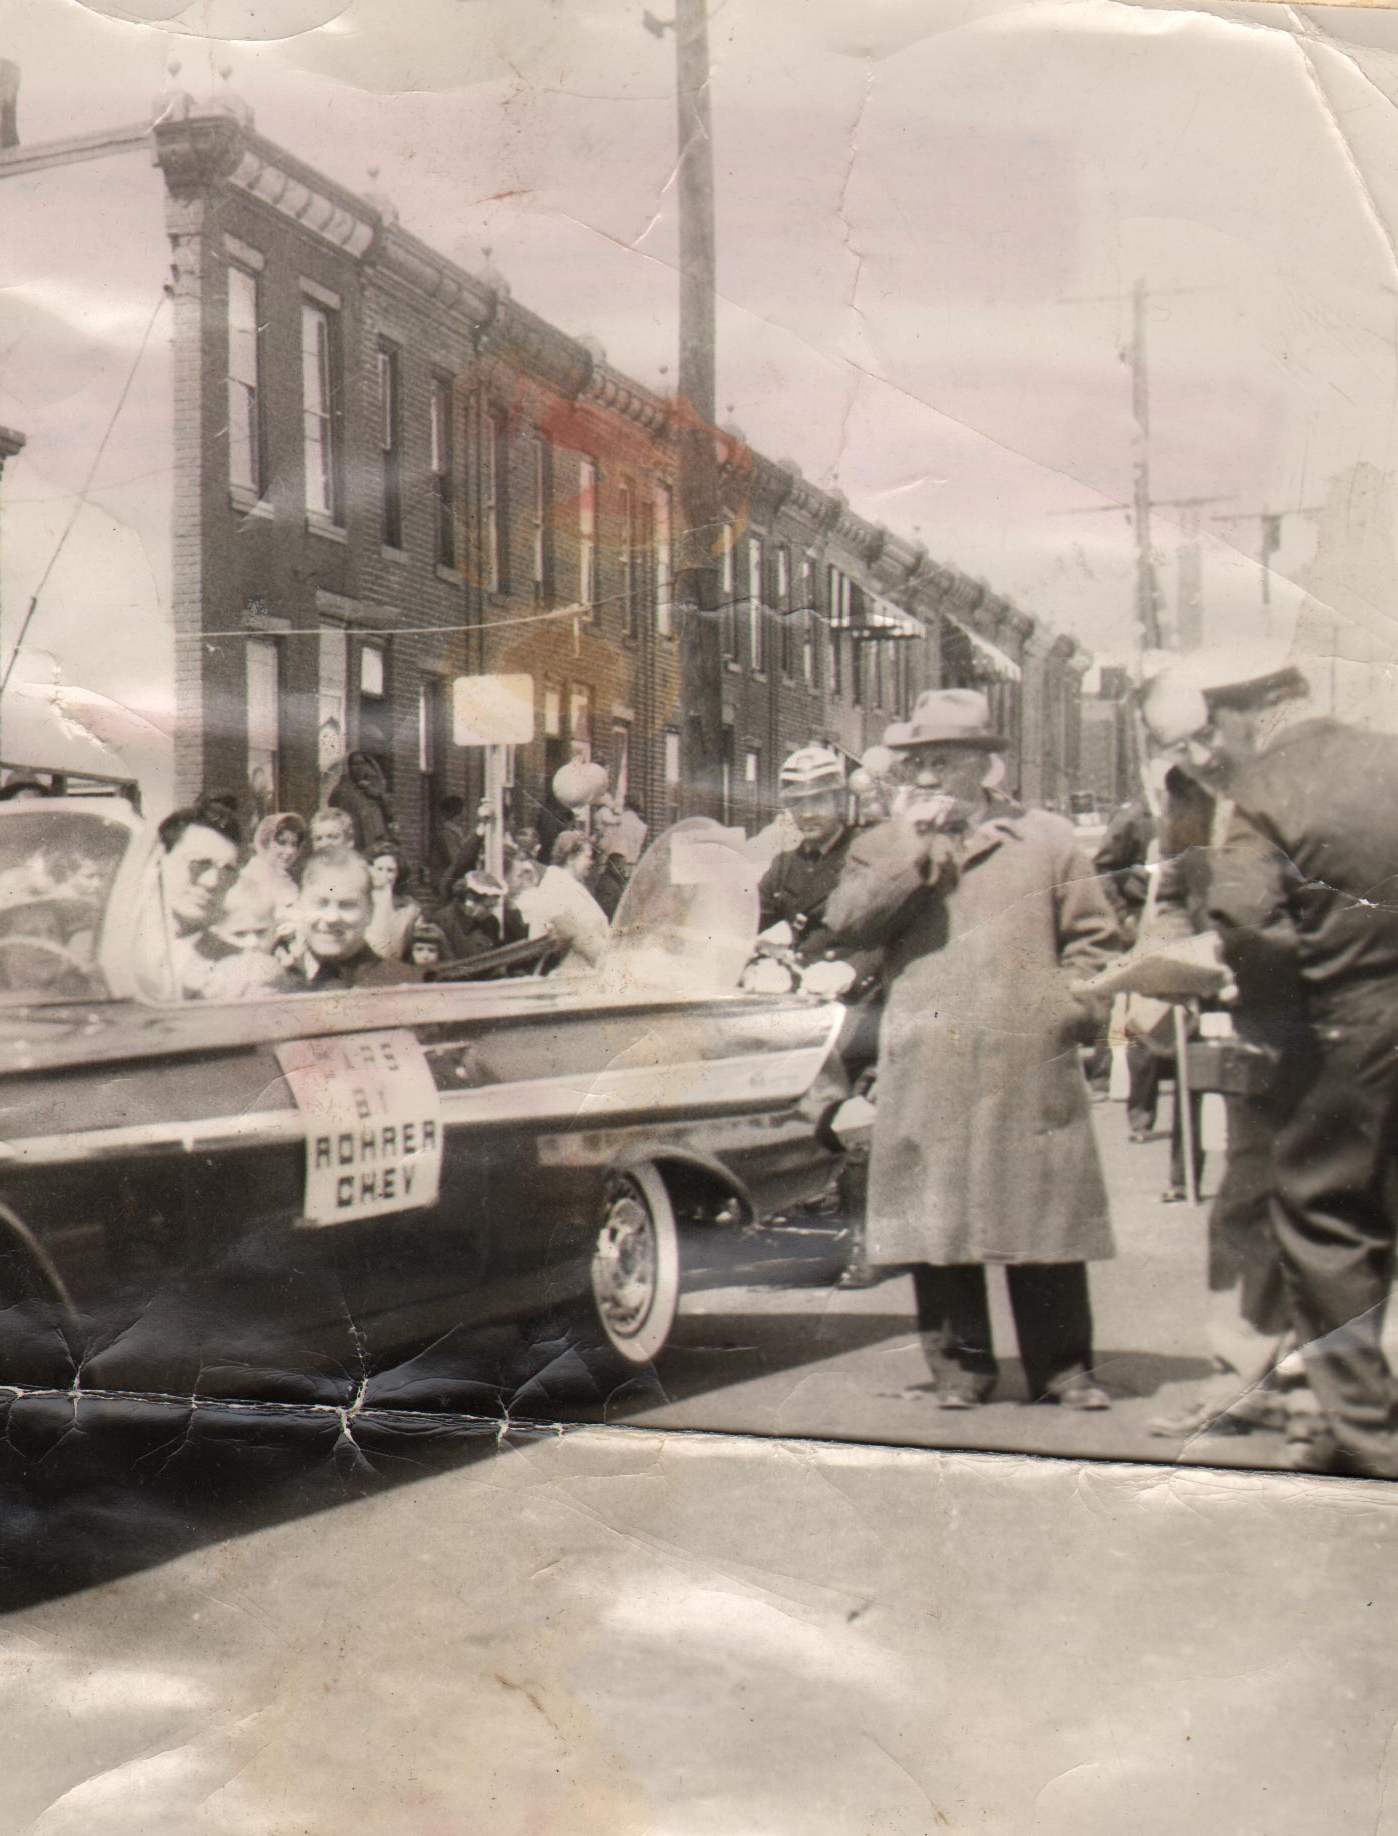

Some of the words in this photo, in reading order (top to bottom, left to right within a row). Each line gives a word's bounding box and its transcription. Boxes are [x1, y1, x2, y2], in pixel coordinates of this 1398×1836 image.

[353, 1082, 389, 1119] BY
[315, 1119, 436, 1170] ROHRER
[336, 1164, 415, 1208] CHEV
